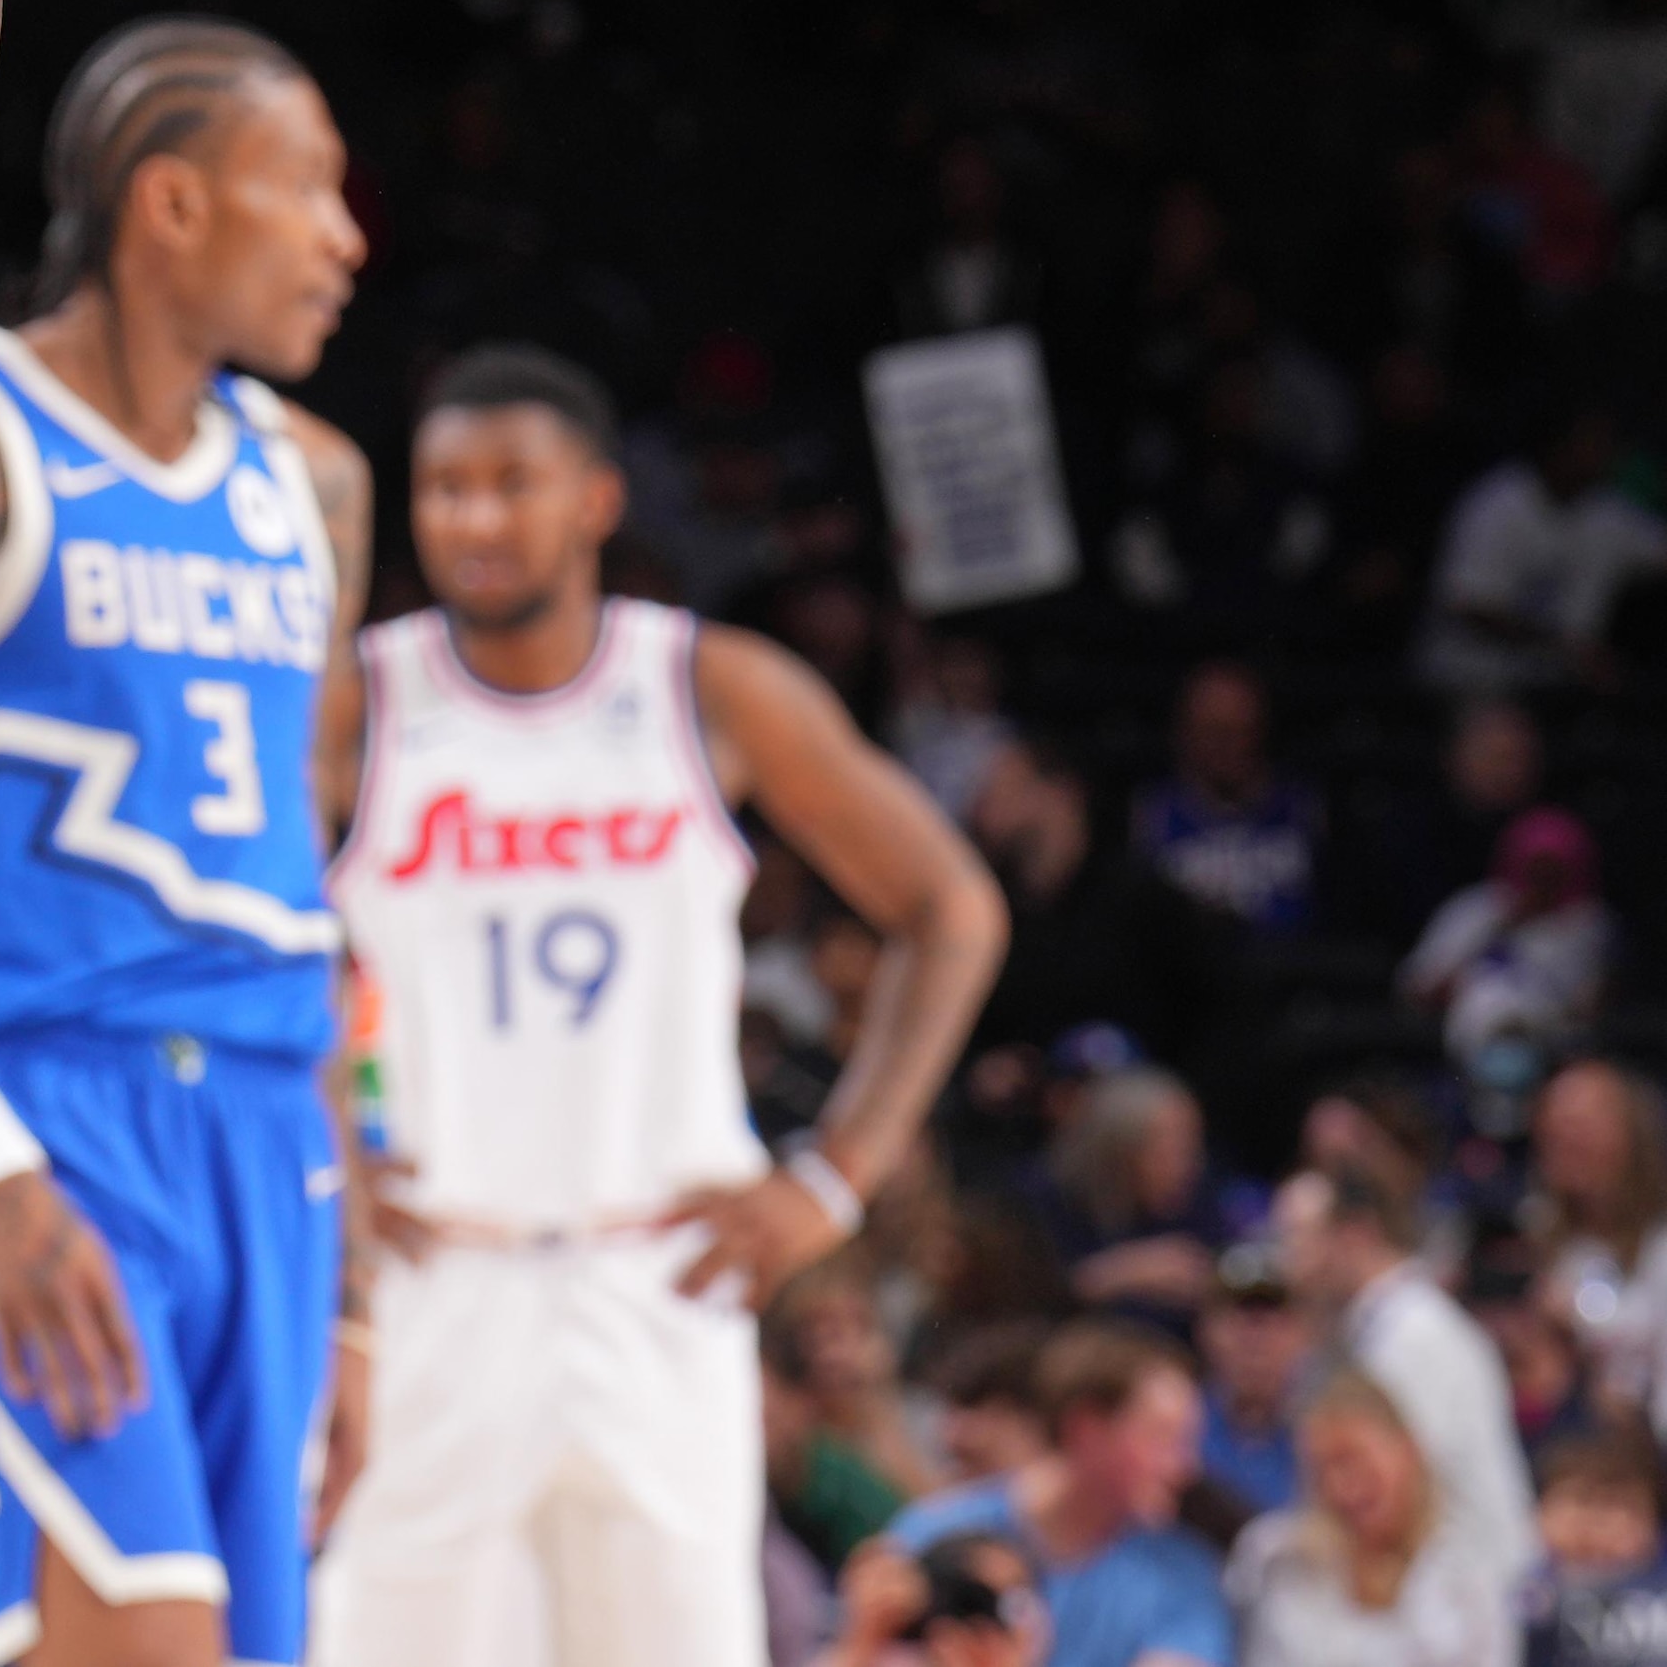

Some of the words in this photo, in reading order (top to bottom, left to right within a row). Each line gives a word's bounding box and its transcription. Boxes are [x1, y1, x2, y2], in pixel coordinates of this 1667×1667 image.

[60, 538, 331, 672] BUCKS
[183, 677, 266, 838] 3
[484, 910, 620, 1031] 19
